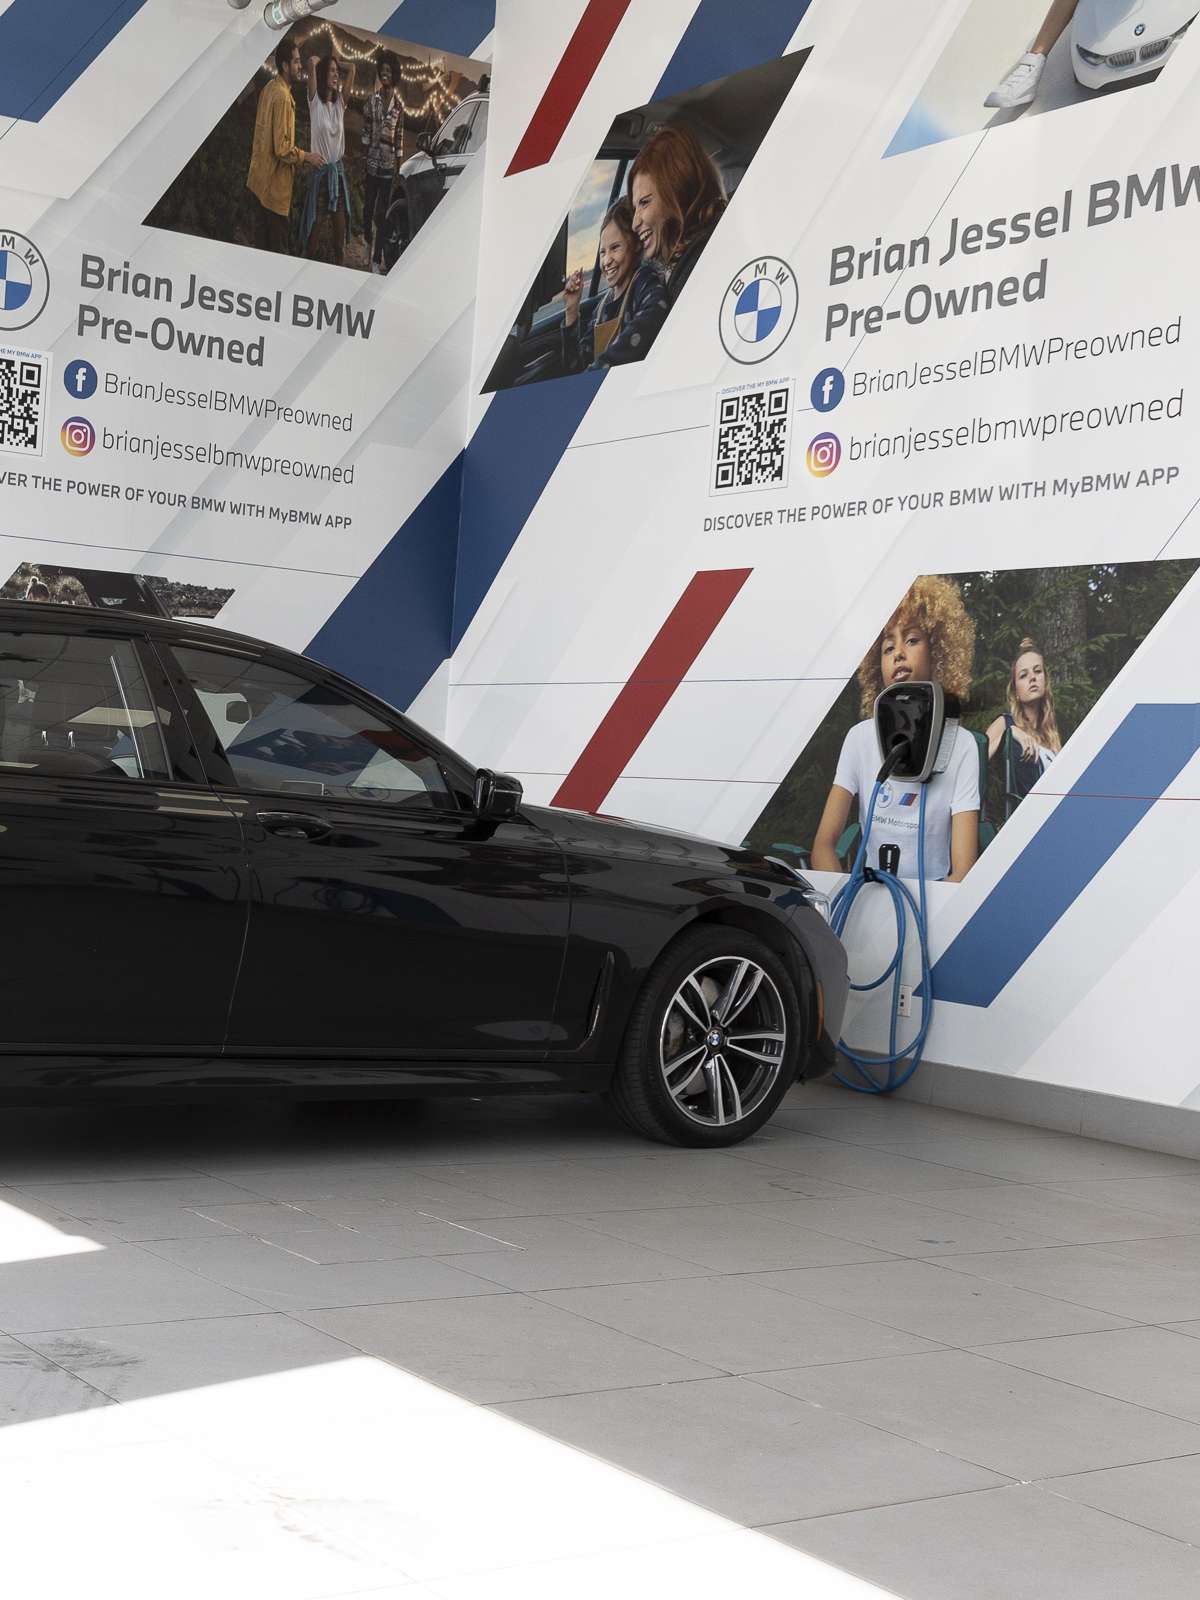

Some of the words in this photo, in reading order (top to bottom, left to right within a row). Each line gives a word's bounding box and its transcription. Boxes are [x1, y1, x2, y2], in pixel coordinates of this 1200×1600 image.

[829, 231, 930, 286] Brian
[939, 190, 1073, 266] Jessel
[81, 254, 172, 302] Brian
[181, 274, 281, 322] Jessel
[292, 294, 375, 339] BMW
[732, 262, 790, 297] BMW
[825, 258, 1048, 342] Pre-Owned
[16, 350, 30, 358] BMW
[78, 304, 264, 366] Pre-Owned
[853, 316, 1181, 396] BrianJesselBMWPreowned
[105, 373, 352, 432] BrianJesselBMWPreowned
[850, 388, 1183, 460] brianjesselbmwpreowned
[103, 427, 354, 484] brianjesselbmwpreowned
[32, 475, 62, 492] THE
[67, 480, 120, 499] POWER
[125, 487, 144, 501] OF
[148, 490, 186, 508] YOUR
[191, 496, 226, 512] BMW
[230, 502, 264, 518] WITH
[269, 507, 321, 525] MyBMW
[325, 515, 351, 529] APP
[704, 511, 773, 531] DISCOVER
[777, 507, 806, 524] THE
[811, 501, 867, 520] POWER
[873, 497, 894, 514] OF
[898, 492, 943, 511] YOUR
[950, 486, 993, 506] BMW
[999, 481, 1046, 501] WITH
[1053, 472, 1130, 497] MyBMW
[1136, 467, 1179, 487] APP
